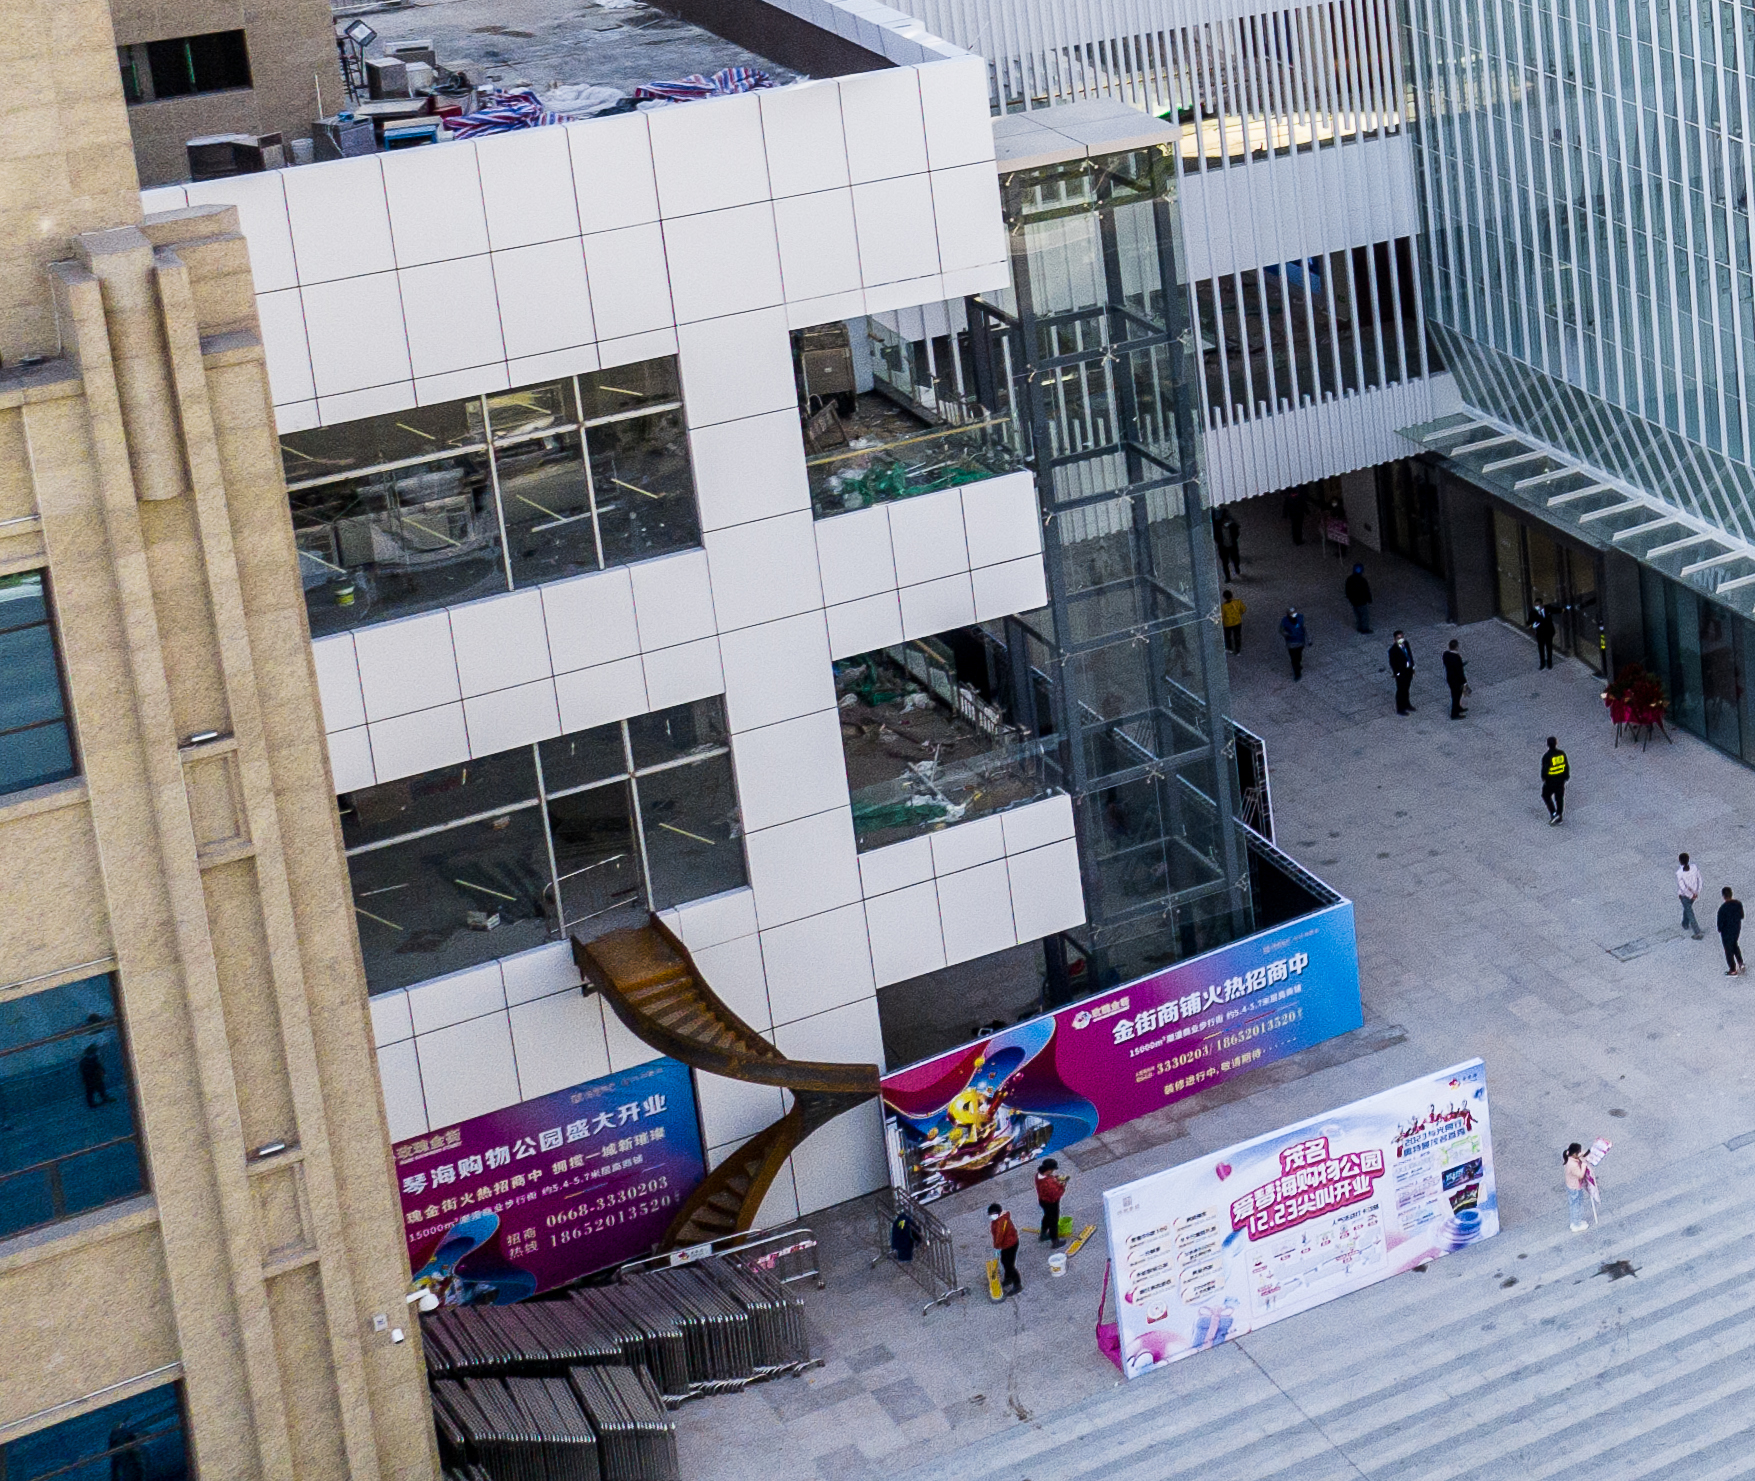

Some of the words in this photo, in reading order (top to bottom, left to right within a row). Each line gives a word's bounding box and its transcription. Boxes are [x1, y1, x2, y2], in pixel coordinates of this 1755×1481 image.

[1112, 952, 1309, 1045] 金街商铺火热招商中
[402, 1093, 667, 1196] 琴海购物公园盛大开业
[1284, 1138, 1326, 1172] 茂名
[546, 1176, 669, 1228] 0668-3330203
[1233, 1150, 1383, 1222] 爱琴海购物公园
[1250, 1175, 1371, 1234] 12.23尖叫开业
[507, 1227, 536, 1245] 招商
[550, 1194, 671, 1248] 18652013520
